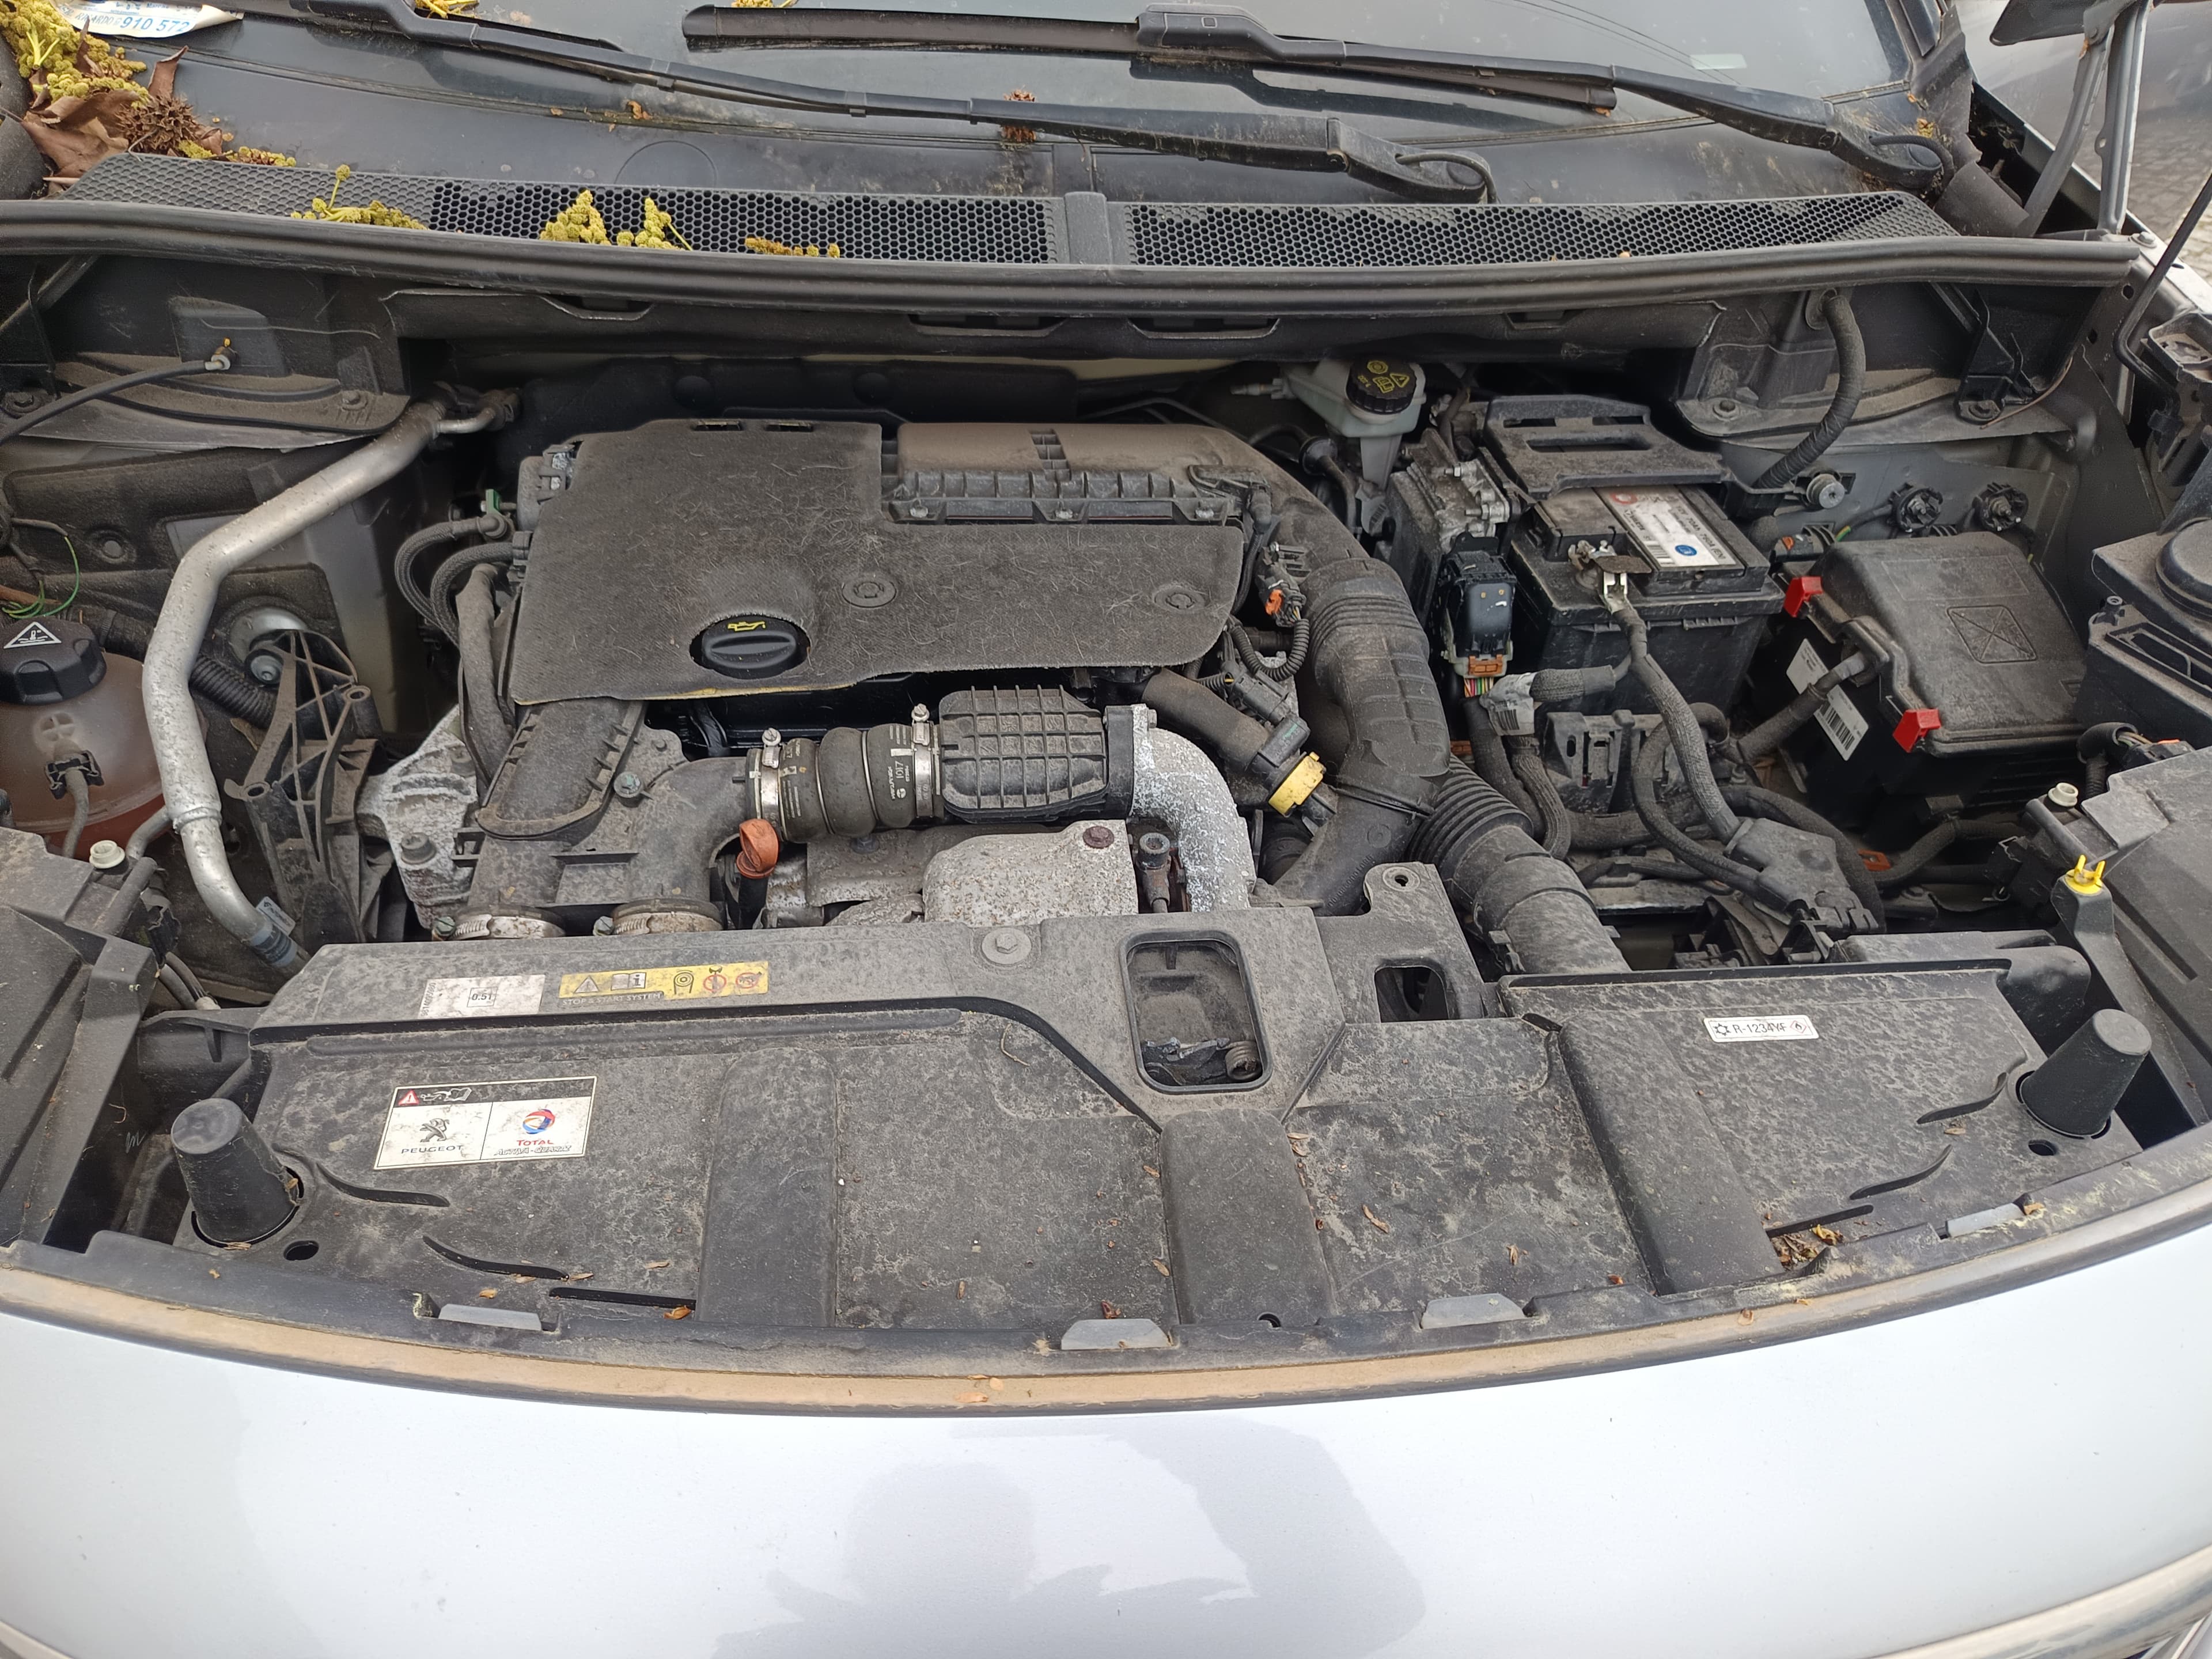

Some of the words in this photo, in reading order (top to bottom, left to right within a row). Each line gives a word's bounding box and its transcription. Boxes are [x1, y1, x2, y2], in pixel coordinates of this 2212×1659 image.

[120, 16, 153, 30] 910
[156, 19, 190, 32] 572
[562, 997, 586, 1006] STOP
[596, 994, 624, 1003] START
[626, 991, 661, 1002] SYSTEM
[1732, 1022, 1786, 1033] R-1234YF
[401, 1145, 464, 1154] PEUGEOT
